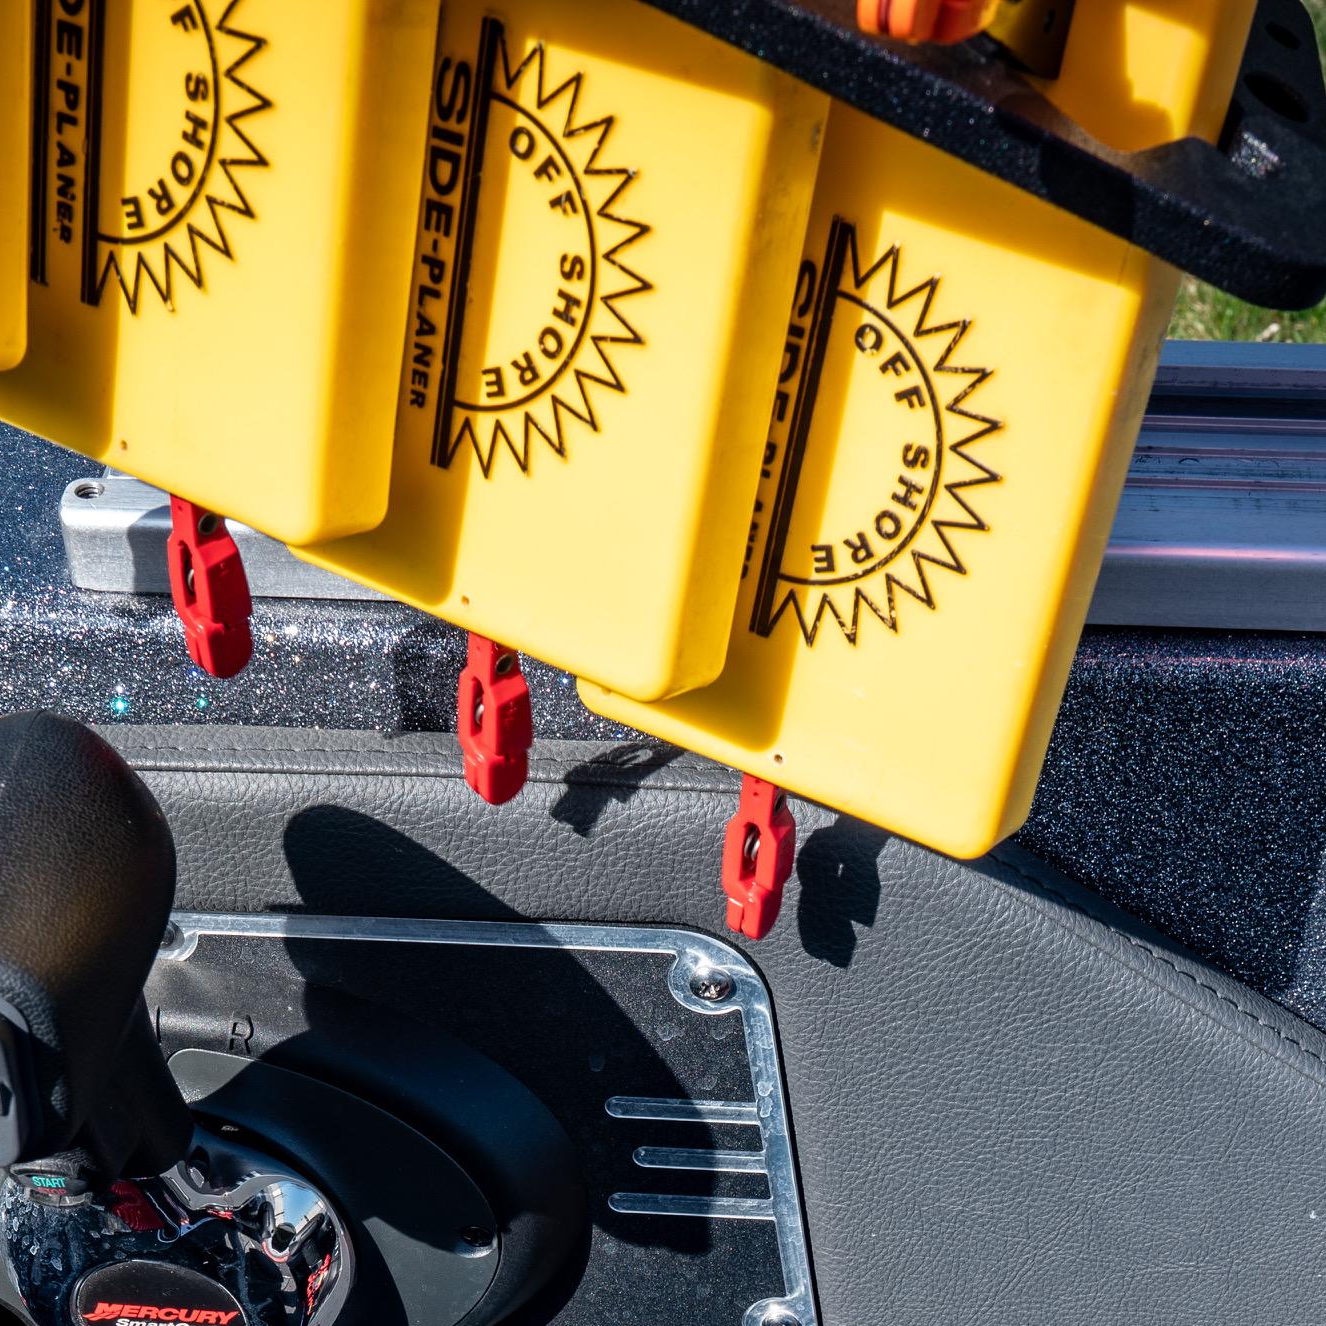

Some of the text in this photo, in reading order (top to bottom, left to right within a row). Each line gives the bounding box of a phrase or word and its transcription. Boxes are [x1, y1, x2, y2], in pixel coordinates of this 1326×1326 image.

[121, 72, 209, 230] SHORE
[409, 57, 471, 409] SIDE-PLANER
[481, 125, 585, 398] OFF SHORE
[810, 322, 930, 574] OFF SHORE
[31, 1175, 66, 1188] START
[85, 1302, 242, 1325] MERCURY
